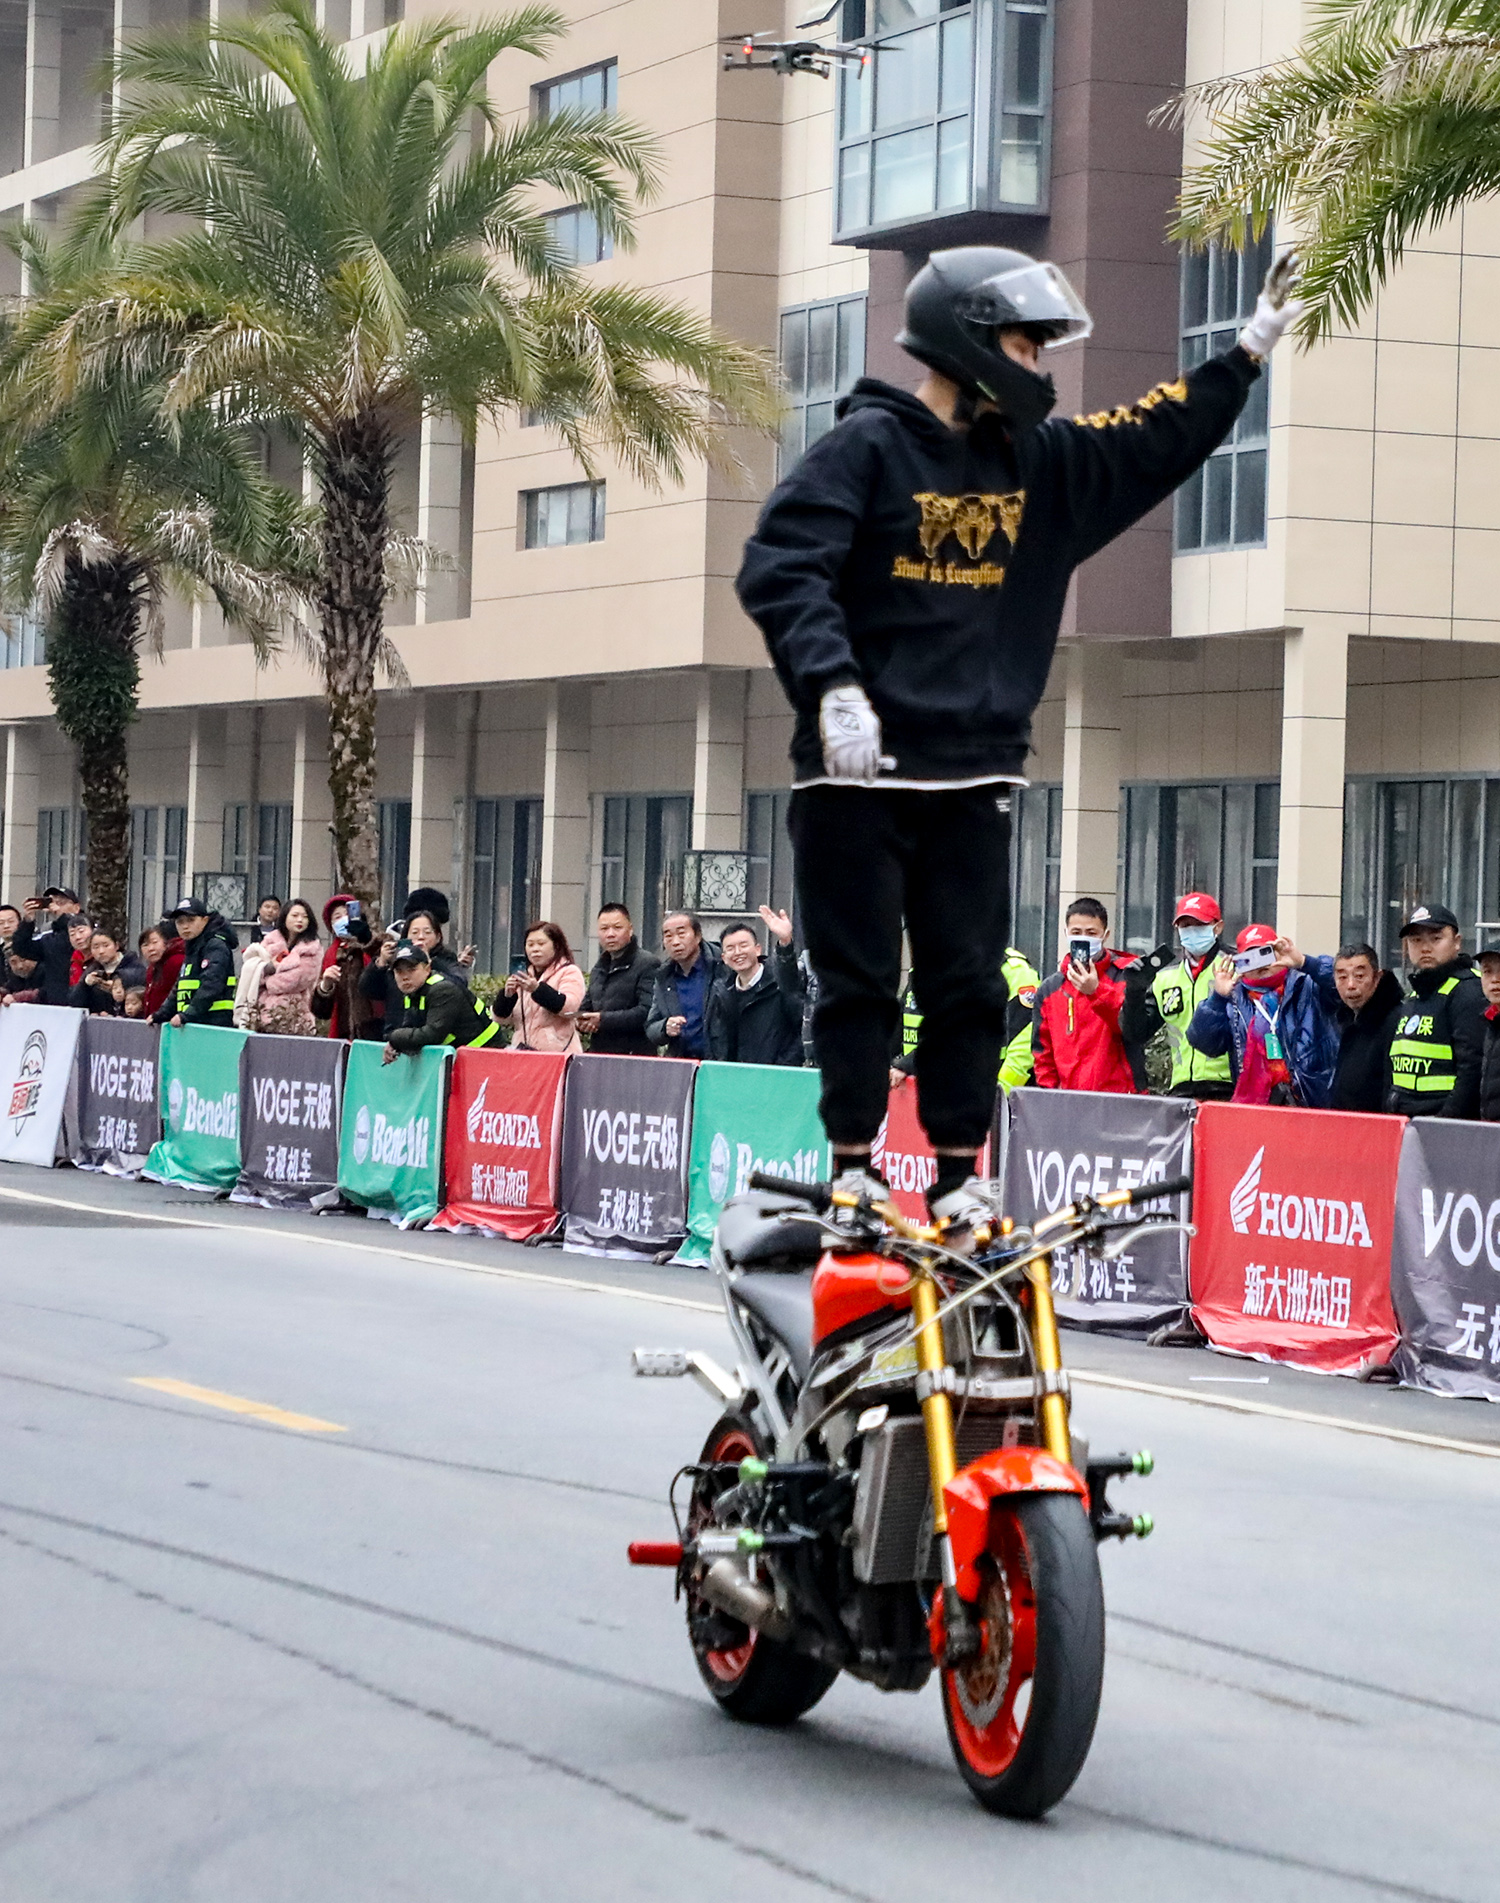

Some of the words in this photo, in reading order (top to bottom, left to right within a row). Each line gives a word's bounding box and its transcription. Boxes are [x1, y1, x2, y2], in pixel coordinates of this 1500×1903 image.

[1416, 1015, 1434, 1036] 保
[90, 1053, 128, 1098] VOGE
[129, 1058, 154, 1103] 无极
[182, 1087, 237, 1139] Benelli
[252, 1076, 301, 1127] VOGE
[303, 1081, 332, 1131] 无极
[96, 1115, 138, 1153] 无极机车
[371, 1113, 429, 1169] Benelli
[480, 1111, 542, 1149] HONDA
[582, 1108, 641, 1166] VOGE
[642, 1113, 678, 1170] 无极
[263, 1145, 312, 1185] 无极机车
[471, 1163, 529, 1208] 新大洲本田
[597, 1187, 654, 1235] 无极机车
[1257, 1192, 1373, 1248] HONDA
[1242, 1262, 1352, 1329] 新大洲本田
